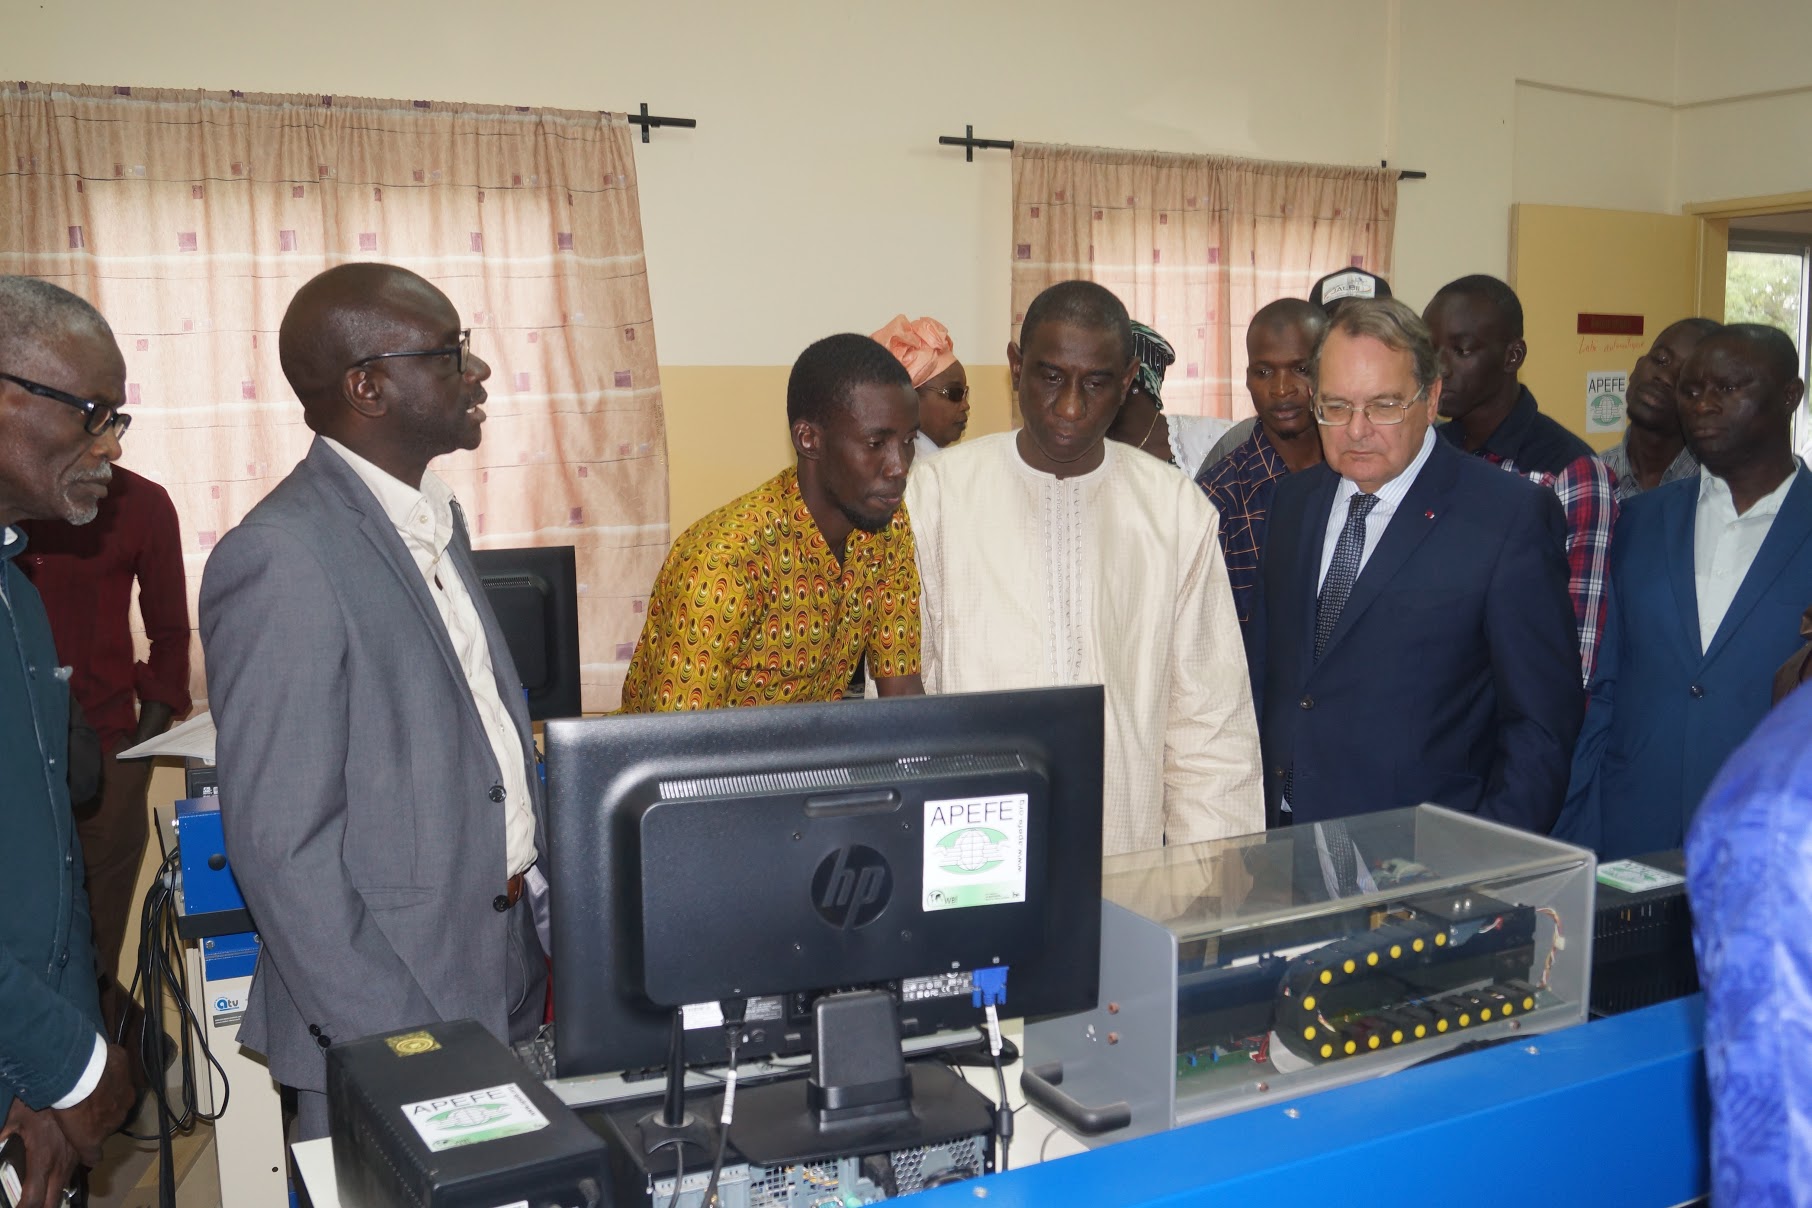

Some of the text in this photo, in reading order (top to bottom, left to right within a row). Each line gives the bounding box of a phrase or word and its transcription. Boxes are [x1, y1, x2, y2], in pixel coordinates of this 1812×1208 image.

[1588, 376, 1626, 394] APEFE
[930, 800, 1014, 827] APEFE
[820, 844, 887, 930] hp
[413, 1088, 508, 1116] APEFE
